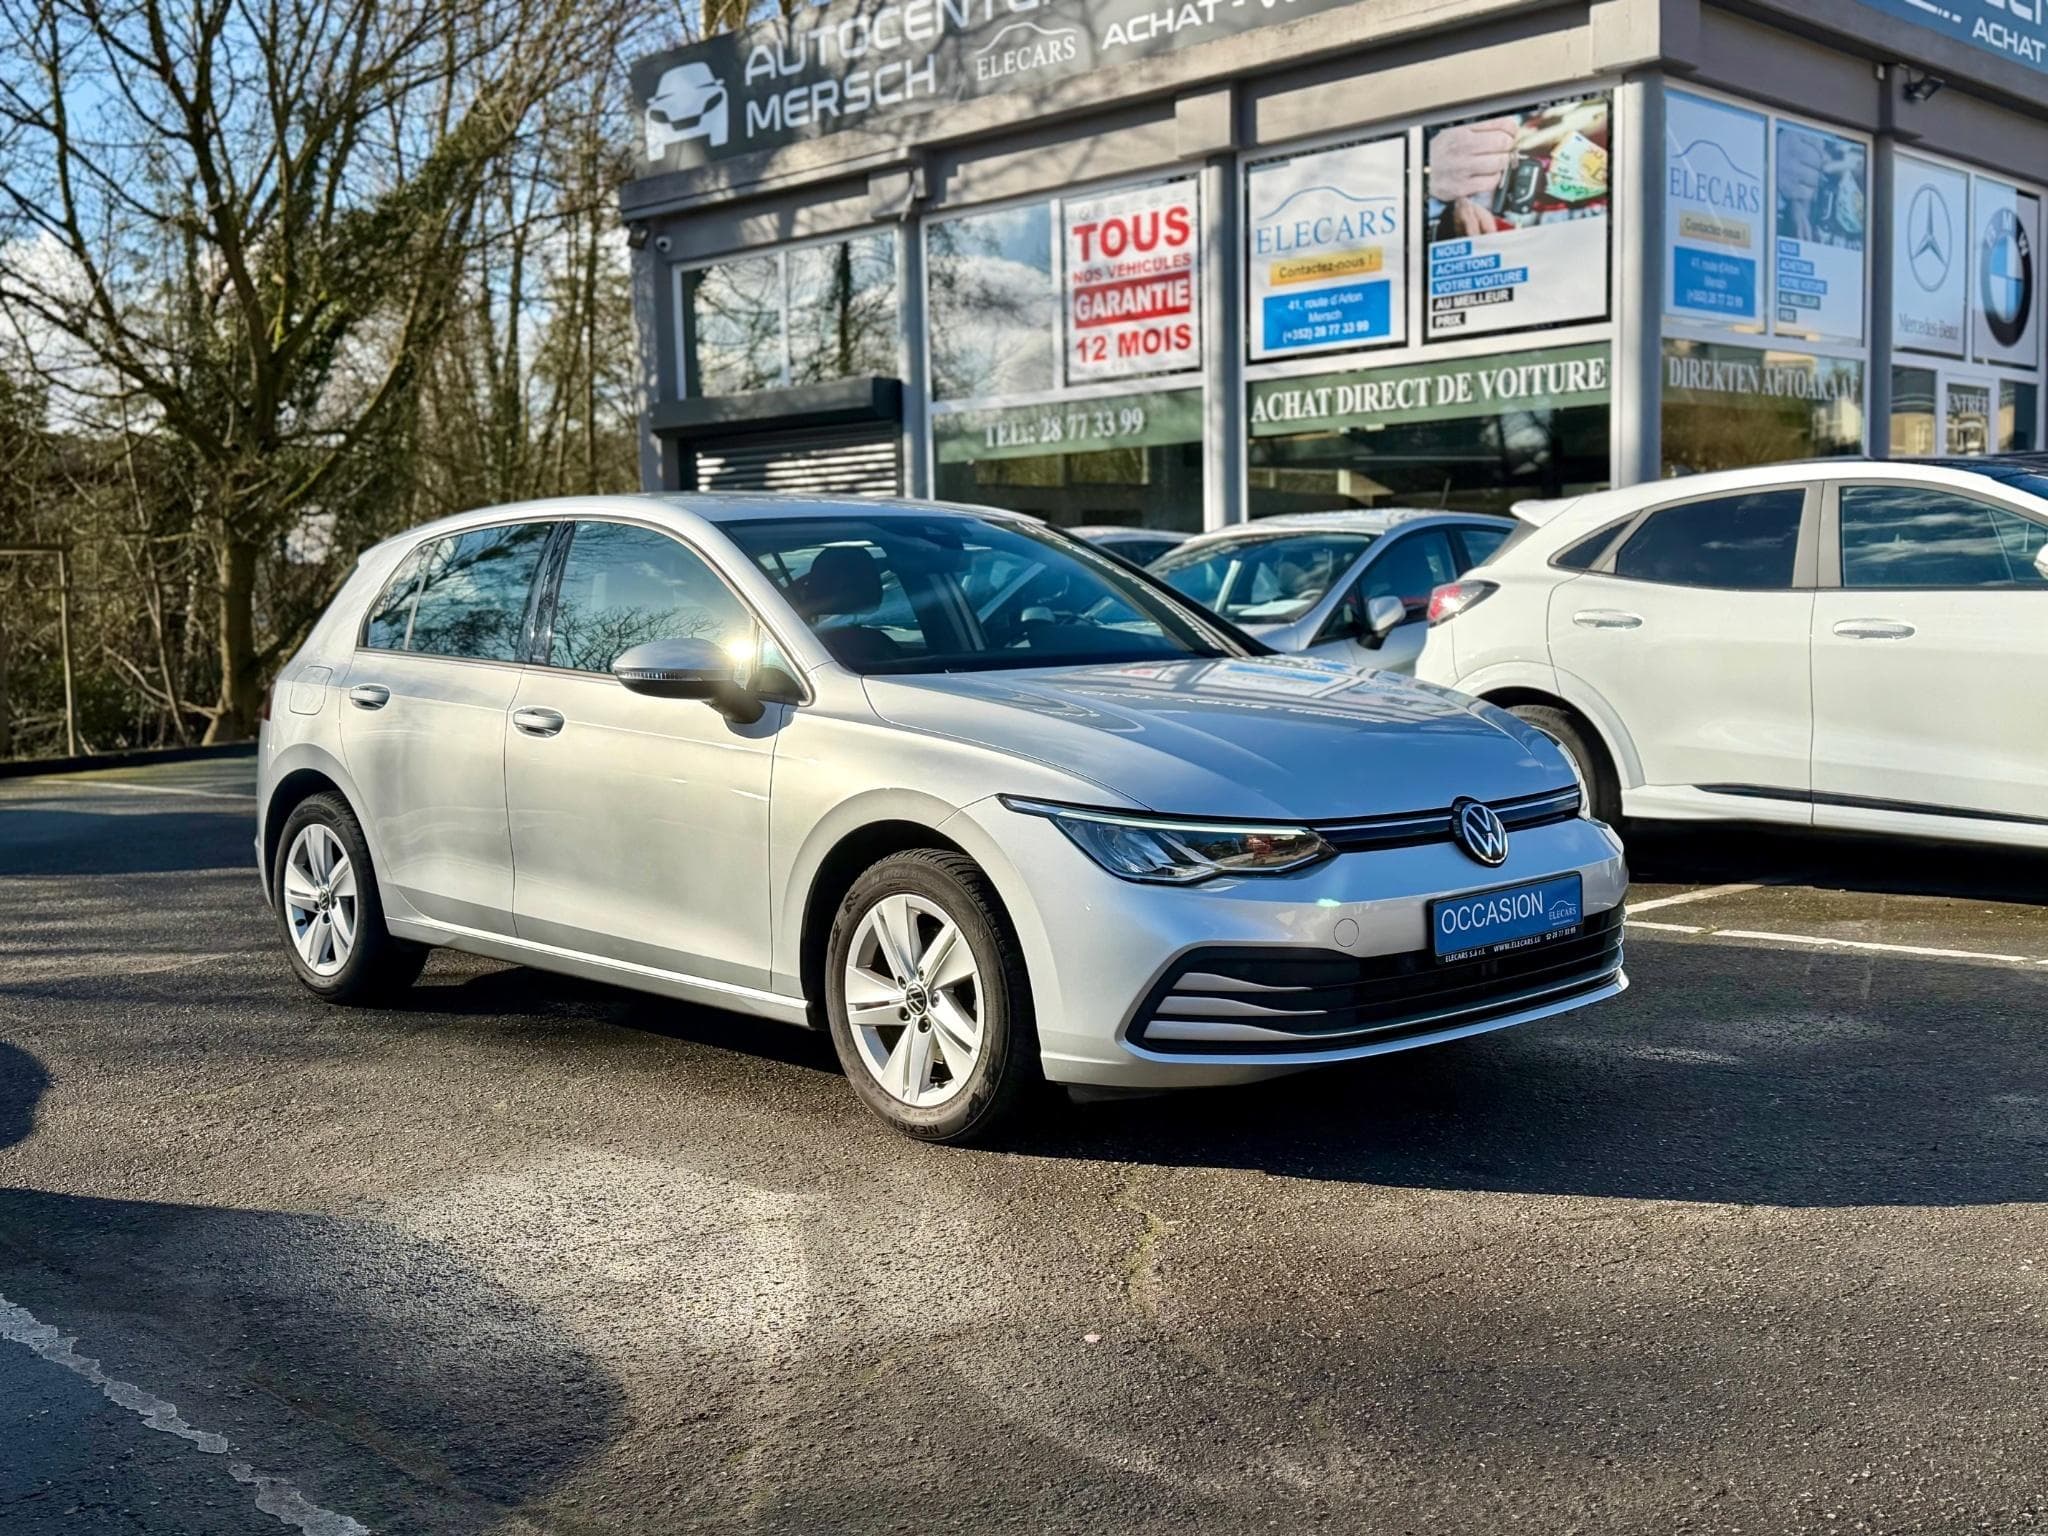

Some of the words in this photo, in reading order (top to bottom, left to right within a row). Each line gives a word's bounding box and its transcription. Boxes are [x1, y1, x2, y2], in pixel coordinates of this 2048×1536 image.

[1101, 0, 1223, 50] ACHAT
[1972, 16, 2047, 64] ACHAT
[976, 34, 1077, 82] ELECARS
[746, 53, 936, 139] MERSCH
[1669, 166, 1760, 214] ELECARS
[1072, 205, 1191, 262] TOUS
[1255, 206, 1397, 255] ELECARS
[1435, 243, 1467, 258] NOUS
[1072, 269, 1103, 284] NOS
[1105, 253, 1192, 279] VEHICULES
[1435, 257, 1496, 275] ACHETONS
[1435, 278, 1473, 293] VOTRE
[1474, 270, 1523, 288] VOITURE
[1075, 279, 1190, 321] GARANTIE
[1435, 297, 1452, 310] AU
[1453, 289, 1509, 307] MEILLEUR
[1076, 334, 1107, 363] 12
[1117, 323, 1192, 359] MOIS
[1328, 323, 1341, 336] 77
[1250, 387, 1332, 423] ACHAT
[1336, 377, 1432, 416] DIRECT
[1436, 371, 1473, 403] DE
[1477, 357, 1606, 400] VOITURE
[1668, 356, 1760, 394] DIREKTEN
[1040, 415, 1063, 443] 28
[1066, 413, 1090, 441] 77
[1092, 410, 1116, 438] 33
[1119, 407, 1145, 435] 99
[1441, 890, 1544, 934] OCCASION
[1548, 906, 1577, 921] ELECARS
[1445, 952, 1469, 963] ELECARS
[1493, 936, 1541, 953] WWW.ELECARS.LU
